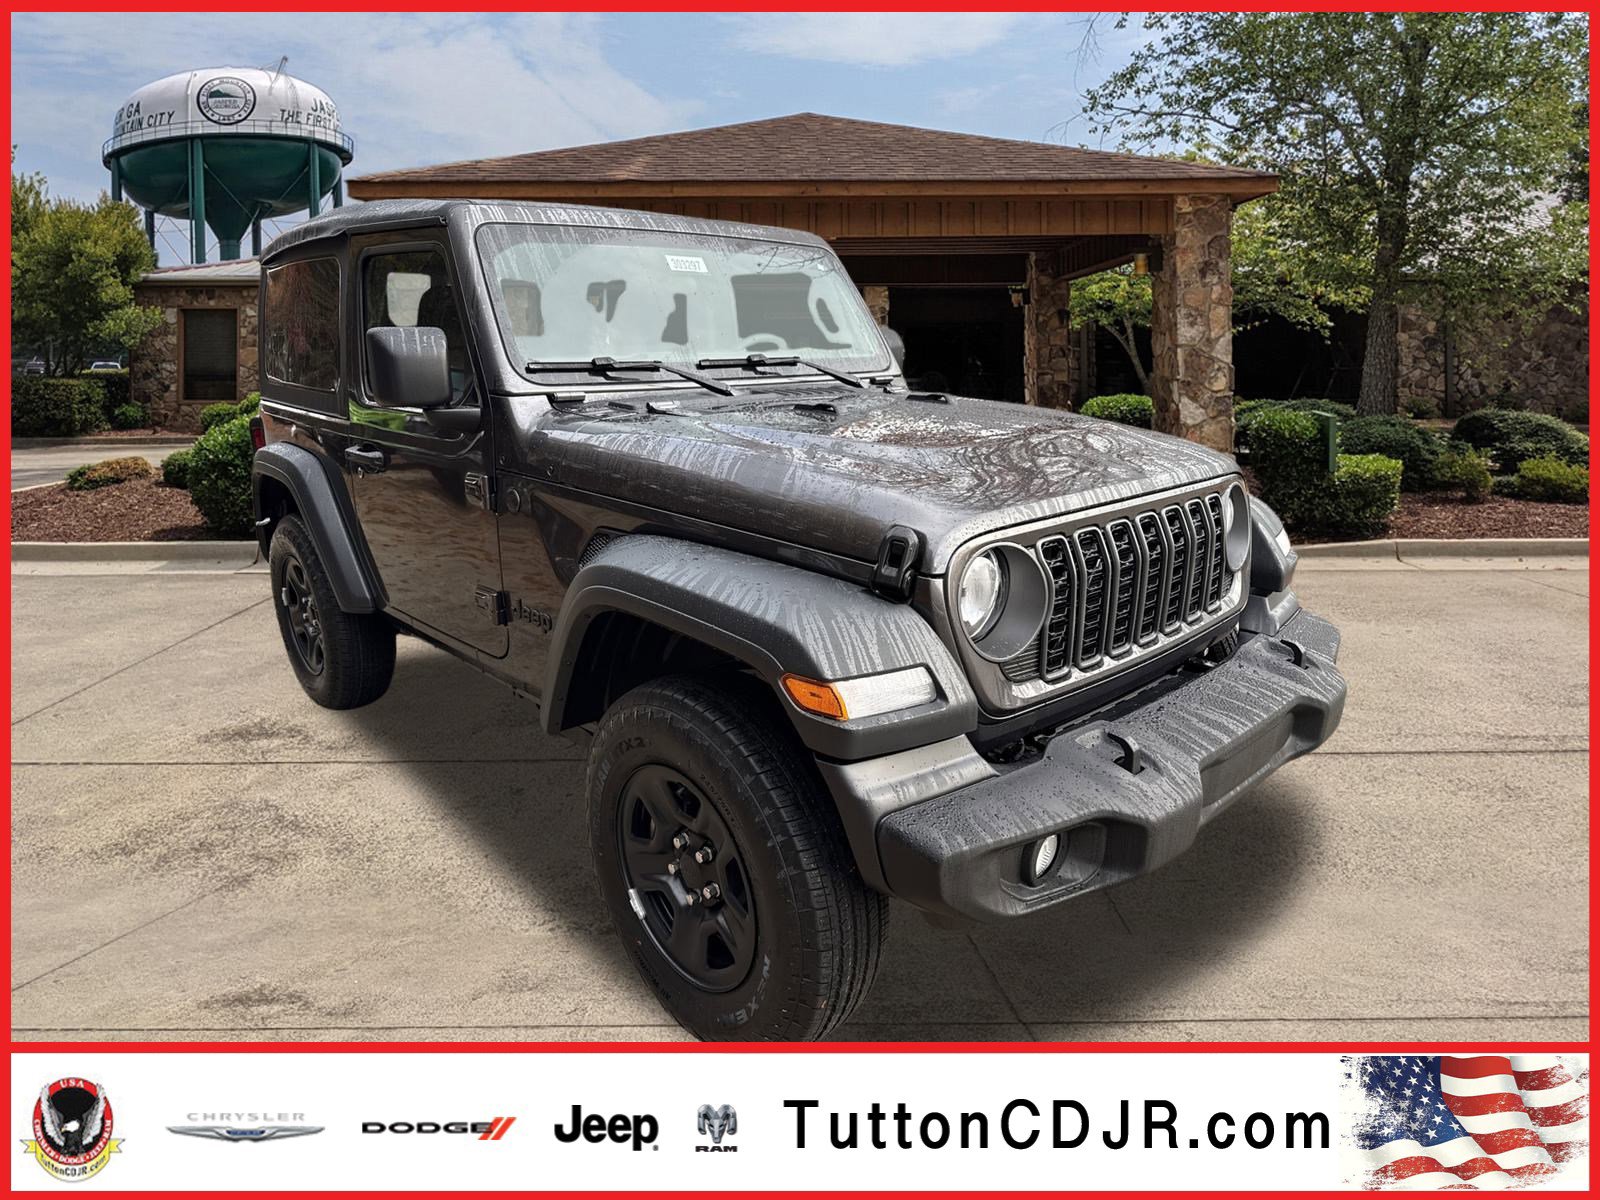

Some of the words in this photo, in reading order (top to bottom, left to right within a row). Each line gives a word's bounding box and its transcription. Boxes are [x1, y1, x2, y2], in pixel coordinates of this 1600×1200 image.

[126, 101, 141, 119] GA
[147, 110, 175, 128] CITY
[280, 108, 302, 124] THE
[306, 113, 332, 130] FIRST
